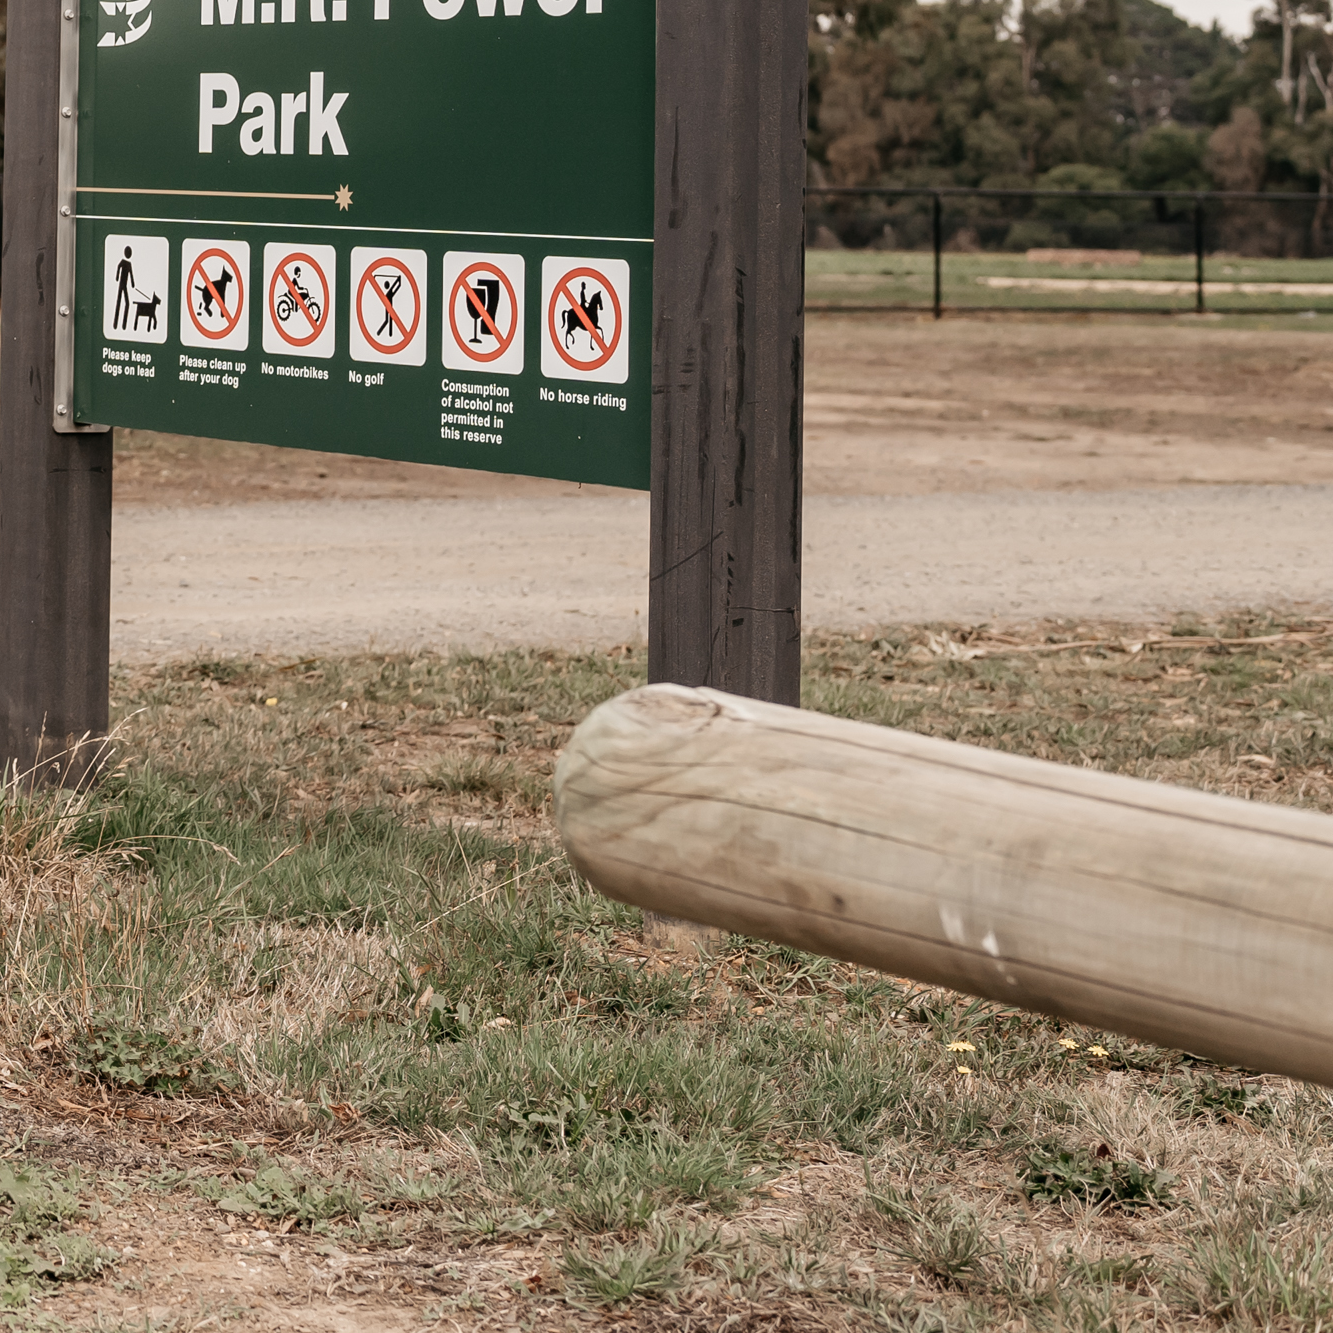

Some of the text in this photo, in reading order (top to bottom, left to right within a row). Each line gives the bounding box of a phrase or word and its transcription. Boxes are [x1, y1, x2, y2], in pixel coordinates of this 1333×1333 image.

[198, 71, 349, 156] Park
[103, 348, 151, 365] Please keep
[180, 355, 246, 374] Please clean up
[102, 363, 155, 377] dogs on lead
[179, 370, 239, 388] after your dog
[261, 362, 328, 380] No motorbikes
[349, 370, 384, 386] No golf
[441, 378, 509, 398] Consumption
[441, 396, 513, 414] of alcohol not
[540, 388, 627, 411] No horse riding
[441, 413, 503, 428] permitted in
[441, 427, 502, 444] this reserve
